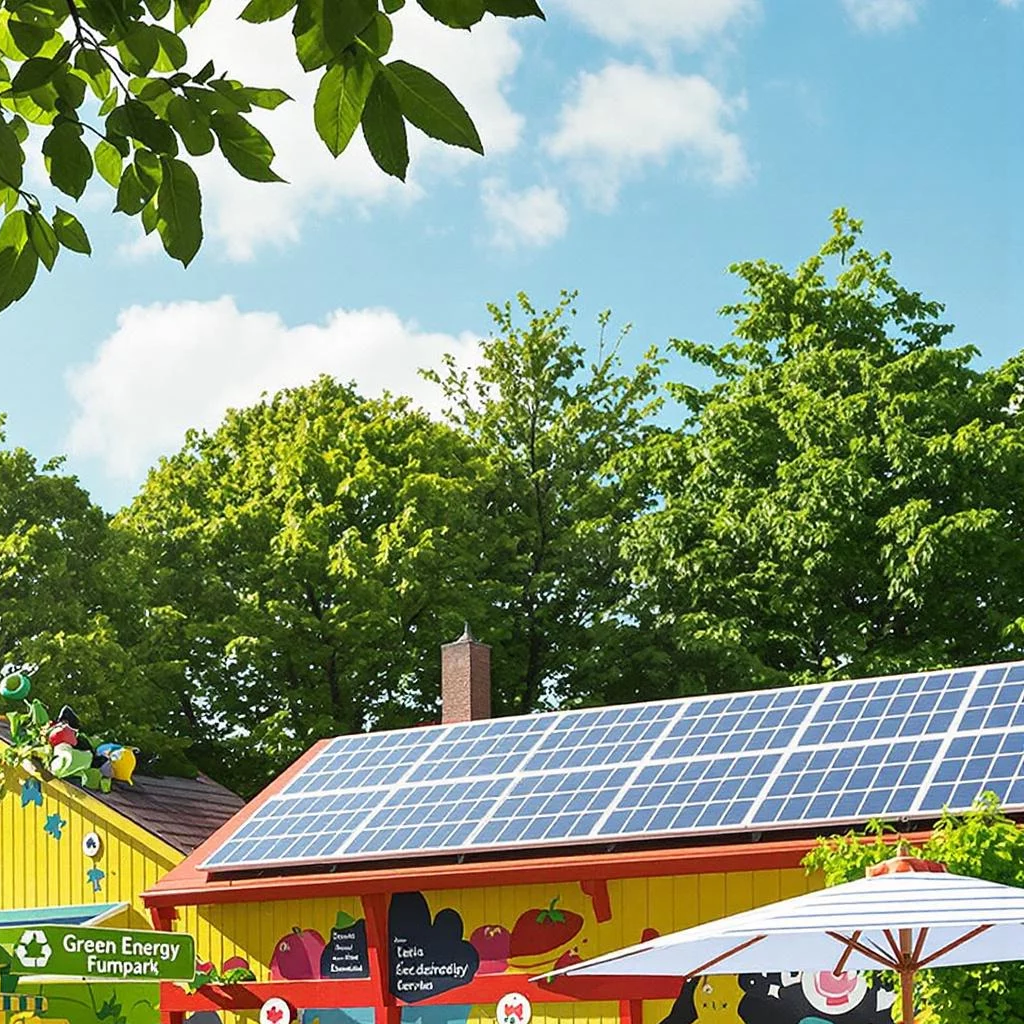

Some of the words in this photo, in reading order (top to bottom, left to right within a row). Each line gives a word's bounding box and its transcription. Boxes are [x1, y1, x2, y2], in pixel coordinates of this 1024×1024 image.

[63, 934, 117, 954] Green
[122, 936, 180, 962] Energy
[87, 955, 159, 978] Fumpark
